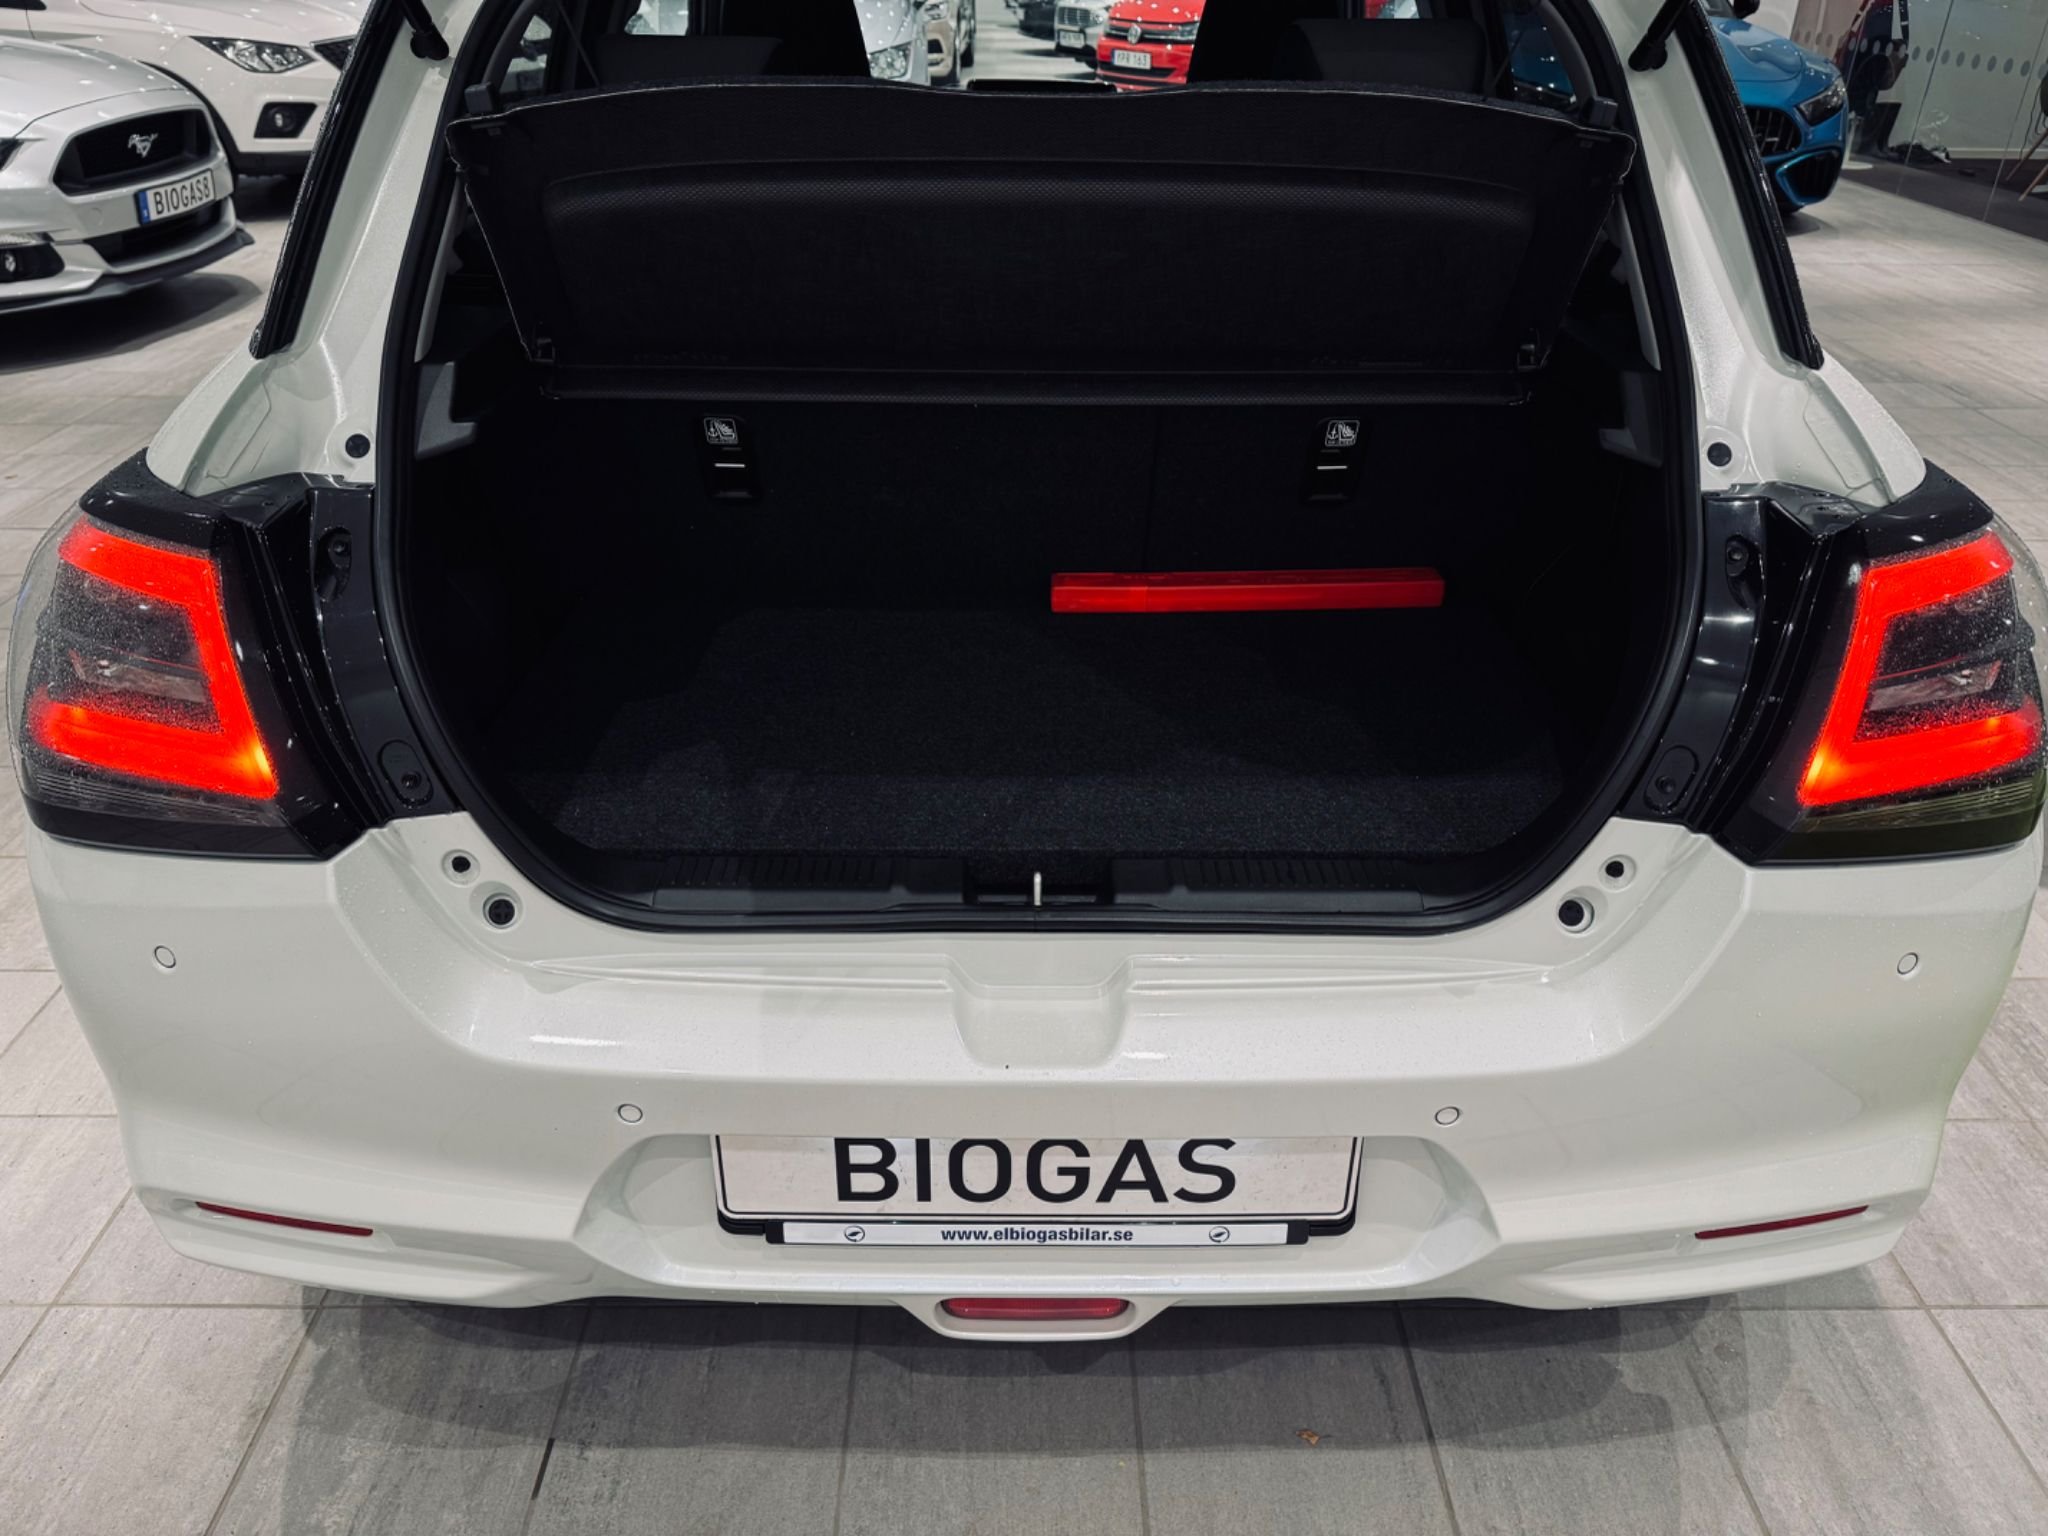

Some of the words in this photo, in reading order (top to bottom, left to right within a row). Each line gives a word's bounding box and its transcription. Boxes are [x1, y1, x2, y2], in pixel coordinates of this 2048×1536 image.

[153, 176, 210, 216] BIOGAS8
[834, 1137, 1236, 1203] BIOGAS
[941, 1227, 1134, 1244] www.elbiogasbilar.se
